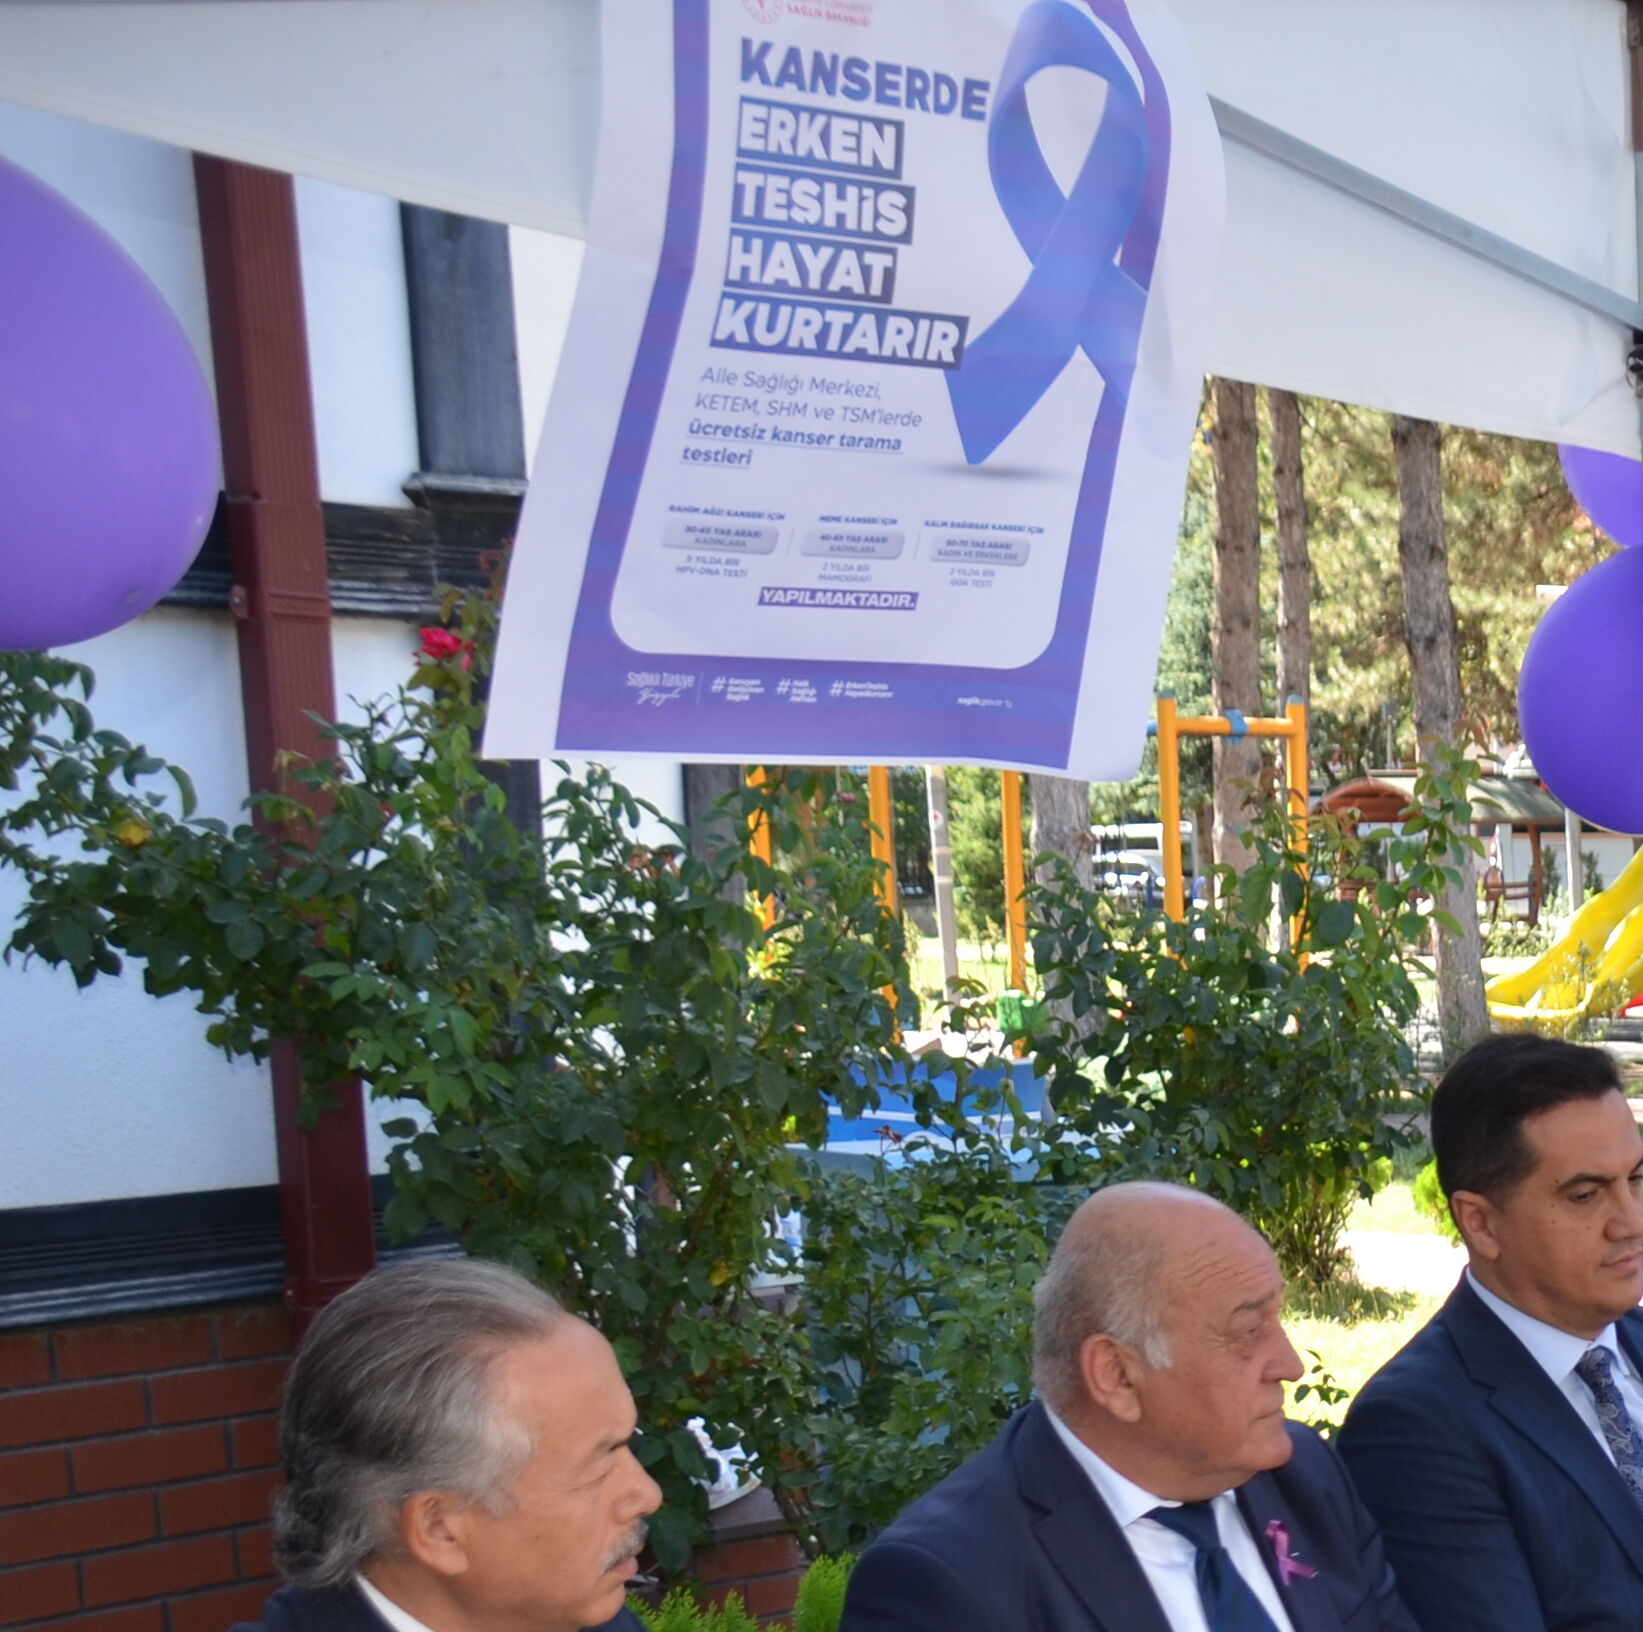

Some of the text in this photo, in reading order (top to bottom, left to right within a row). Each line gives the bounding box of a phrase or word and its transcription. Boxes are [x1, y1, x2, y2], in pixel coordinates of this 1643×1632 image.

[740, 36, 990, 122] KANSERDE
[738, 101, 897, 171] ERKEN
[727, 235, 893, 297] HAYAT
[714, 298, 960, 364] KURTARIR
[695, 392, 760, 415] KETEM,
[766, 400, 808, 418] SHM
[813, 406, 835, 421] ve
[700, 367, 882, 400] Aile Sağlığı Merkezi,
[682, 446, 753, 466] testleri
[688, 418, 902, 451] ücretsiz kanser tarama
